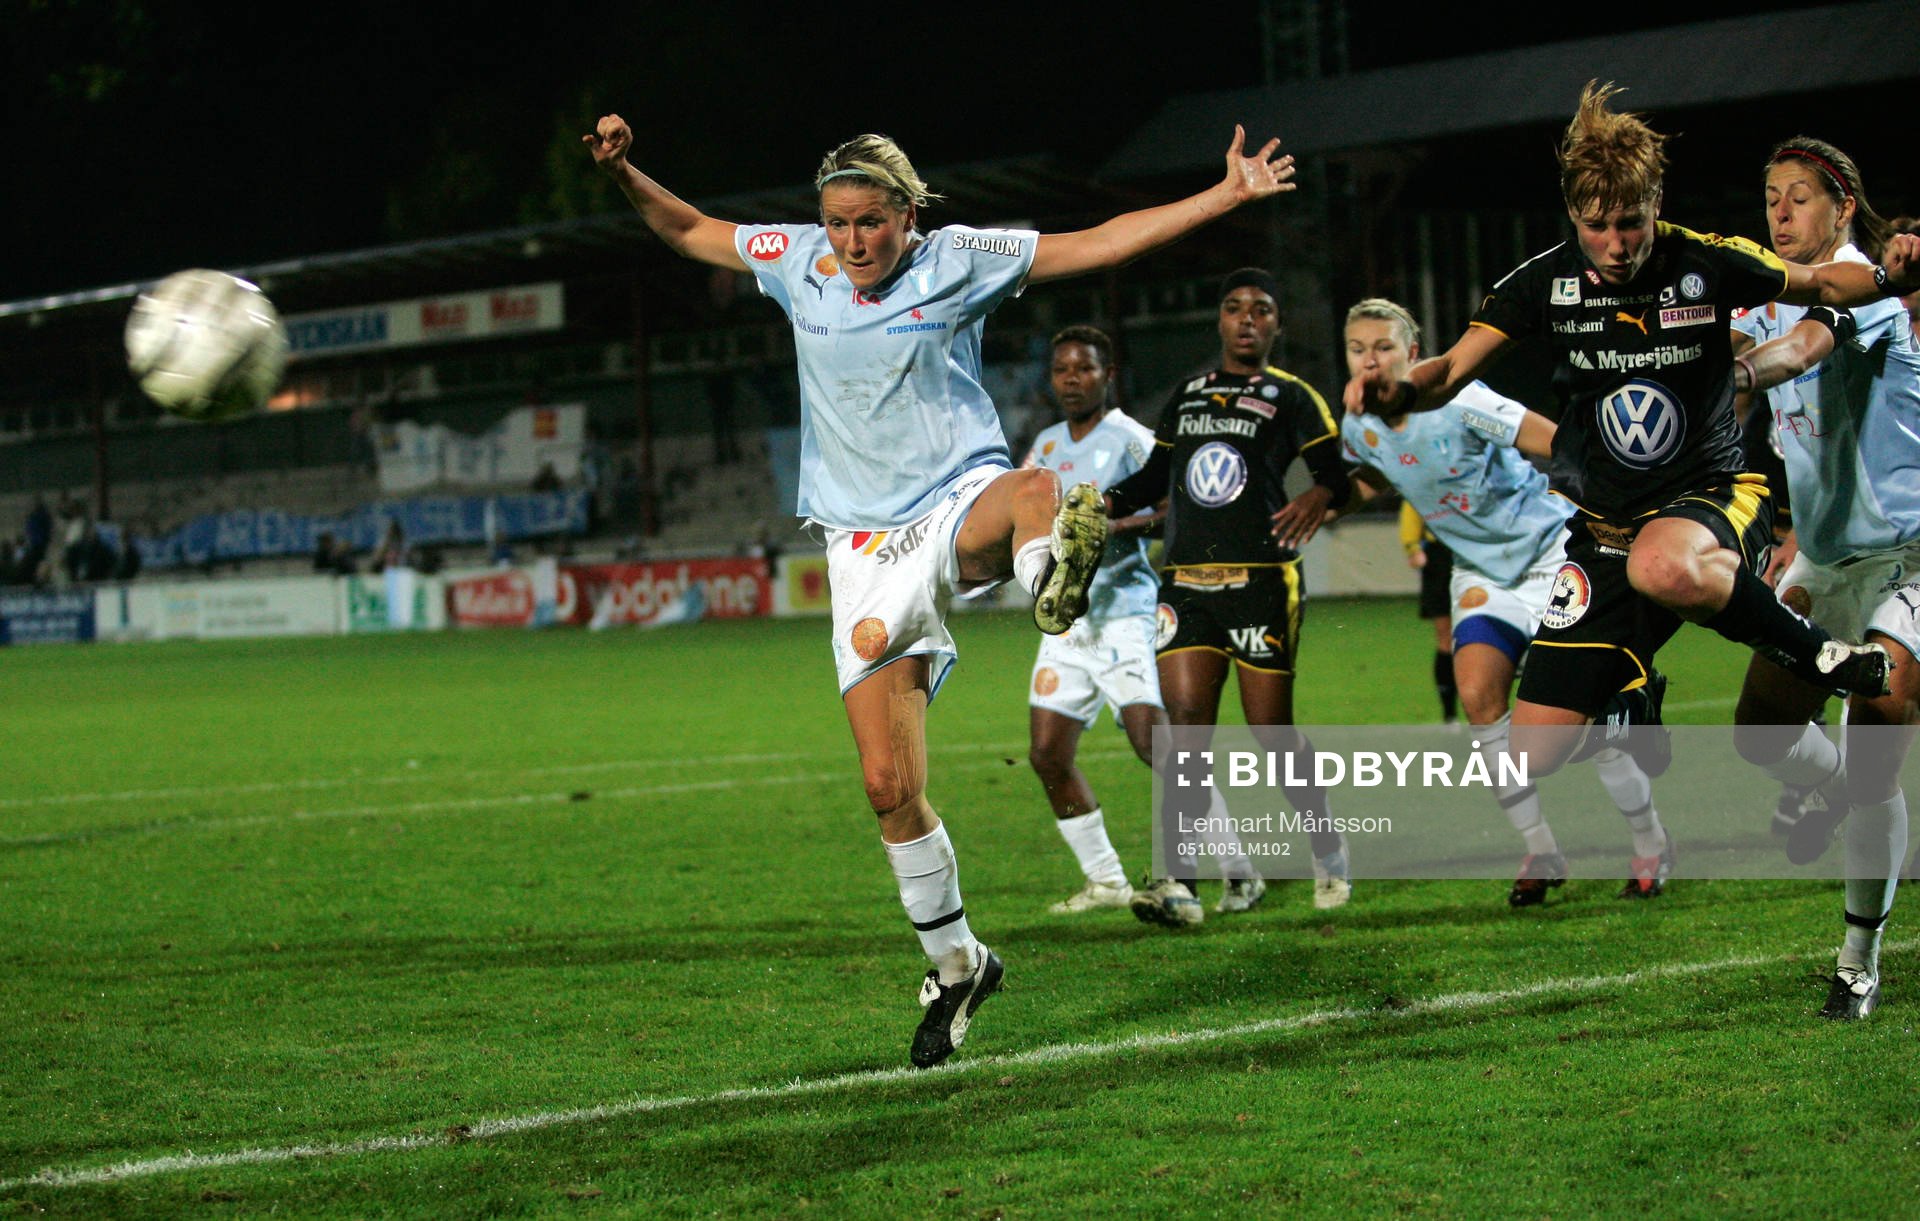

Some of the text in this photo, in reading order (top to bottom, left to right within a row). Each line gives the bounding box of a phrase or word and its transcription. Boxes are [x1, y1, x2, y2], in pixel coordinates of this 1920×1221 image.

[750, 234, 784, 255] AXA
[953, 234, 1021, 257] STADIUM
[852, 288, 881, 306] ICA
[1663, 307, 1713, 322] BENTOUR
[886, 321, 947, 335] SYDSVENSKAN
[1552, 319, 1605, 334] Folksam
[1597, 343, 1704, 373] Myresjöhus
[1177, 414, 1257, 438] Folksam
[1228, 626, 1270, 652] VK
